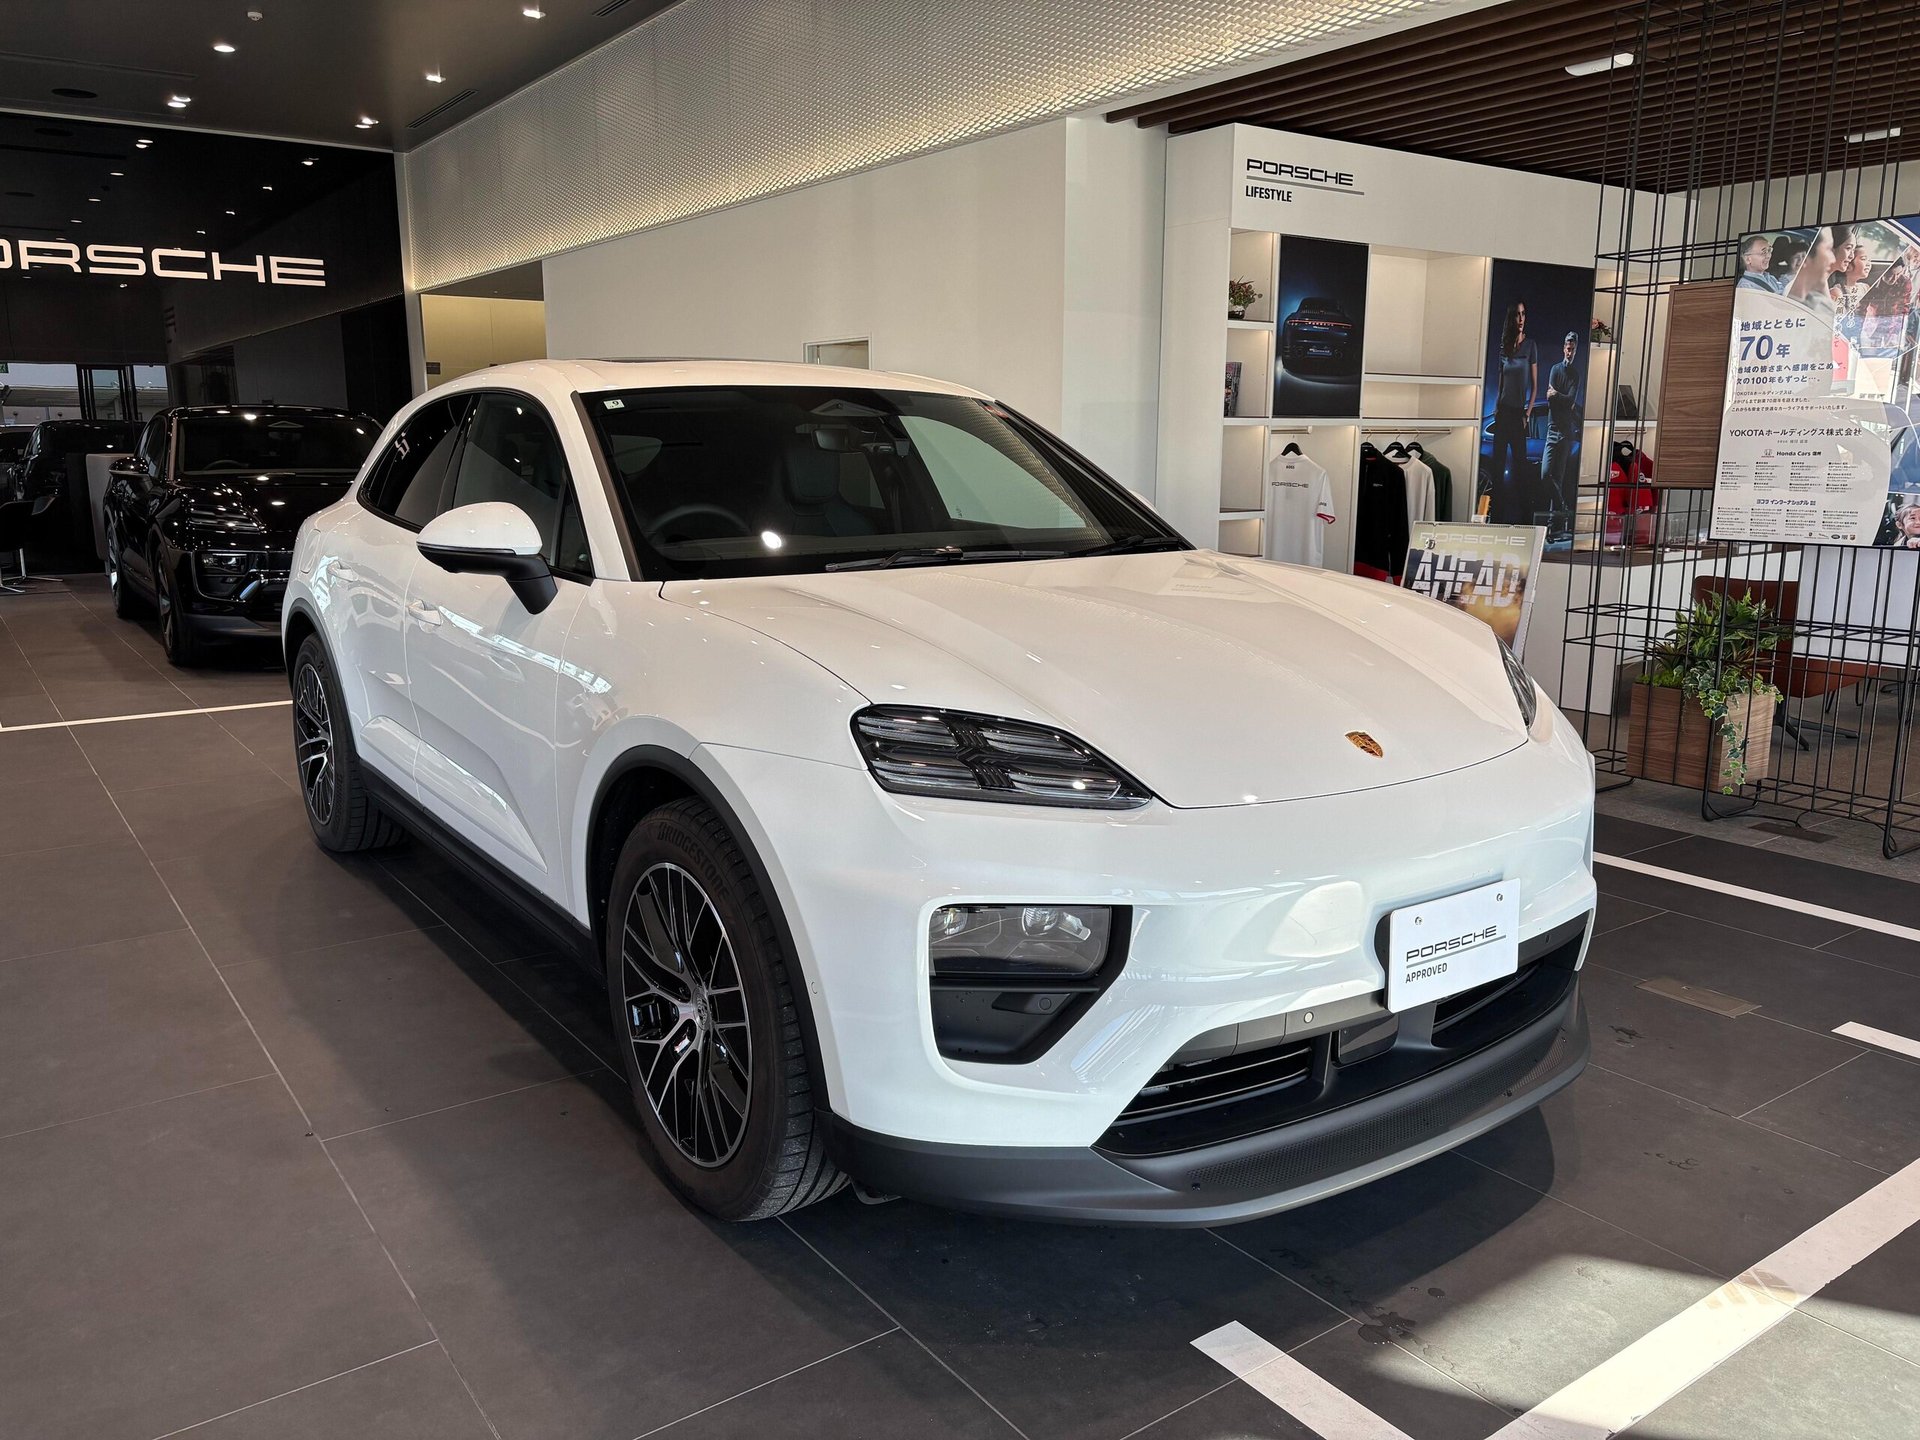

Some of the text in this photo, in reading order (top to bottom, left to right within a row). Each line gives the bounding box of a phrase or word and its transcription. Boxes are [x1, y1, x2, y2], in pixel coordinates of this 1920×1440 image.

[1247, 158, 1354, 186] PORSCHE
[1245, 185, 1292, 202] LIFESTYLE
[0, 238, 326, 287] RSCHE
[1740, 318, 1806, 331] 地域とともに
[1740, 335, 1790, 361] 70年
[1729, 428, 1862, 437] YOKOTAホールディングス株式会社
[1419, 532, 1527, 547] PORSCHE
[1411, 549, 1521, 607] AHEAD
[1406, 925, 1497, 963] PORSCHE
[1405, 962, 1448, 984] APPROVED
